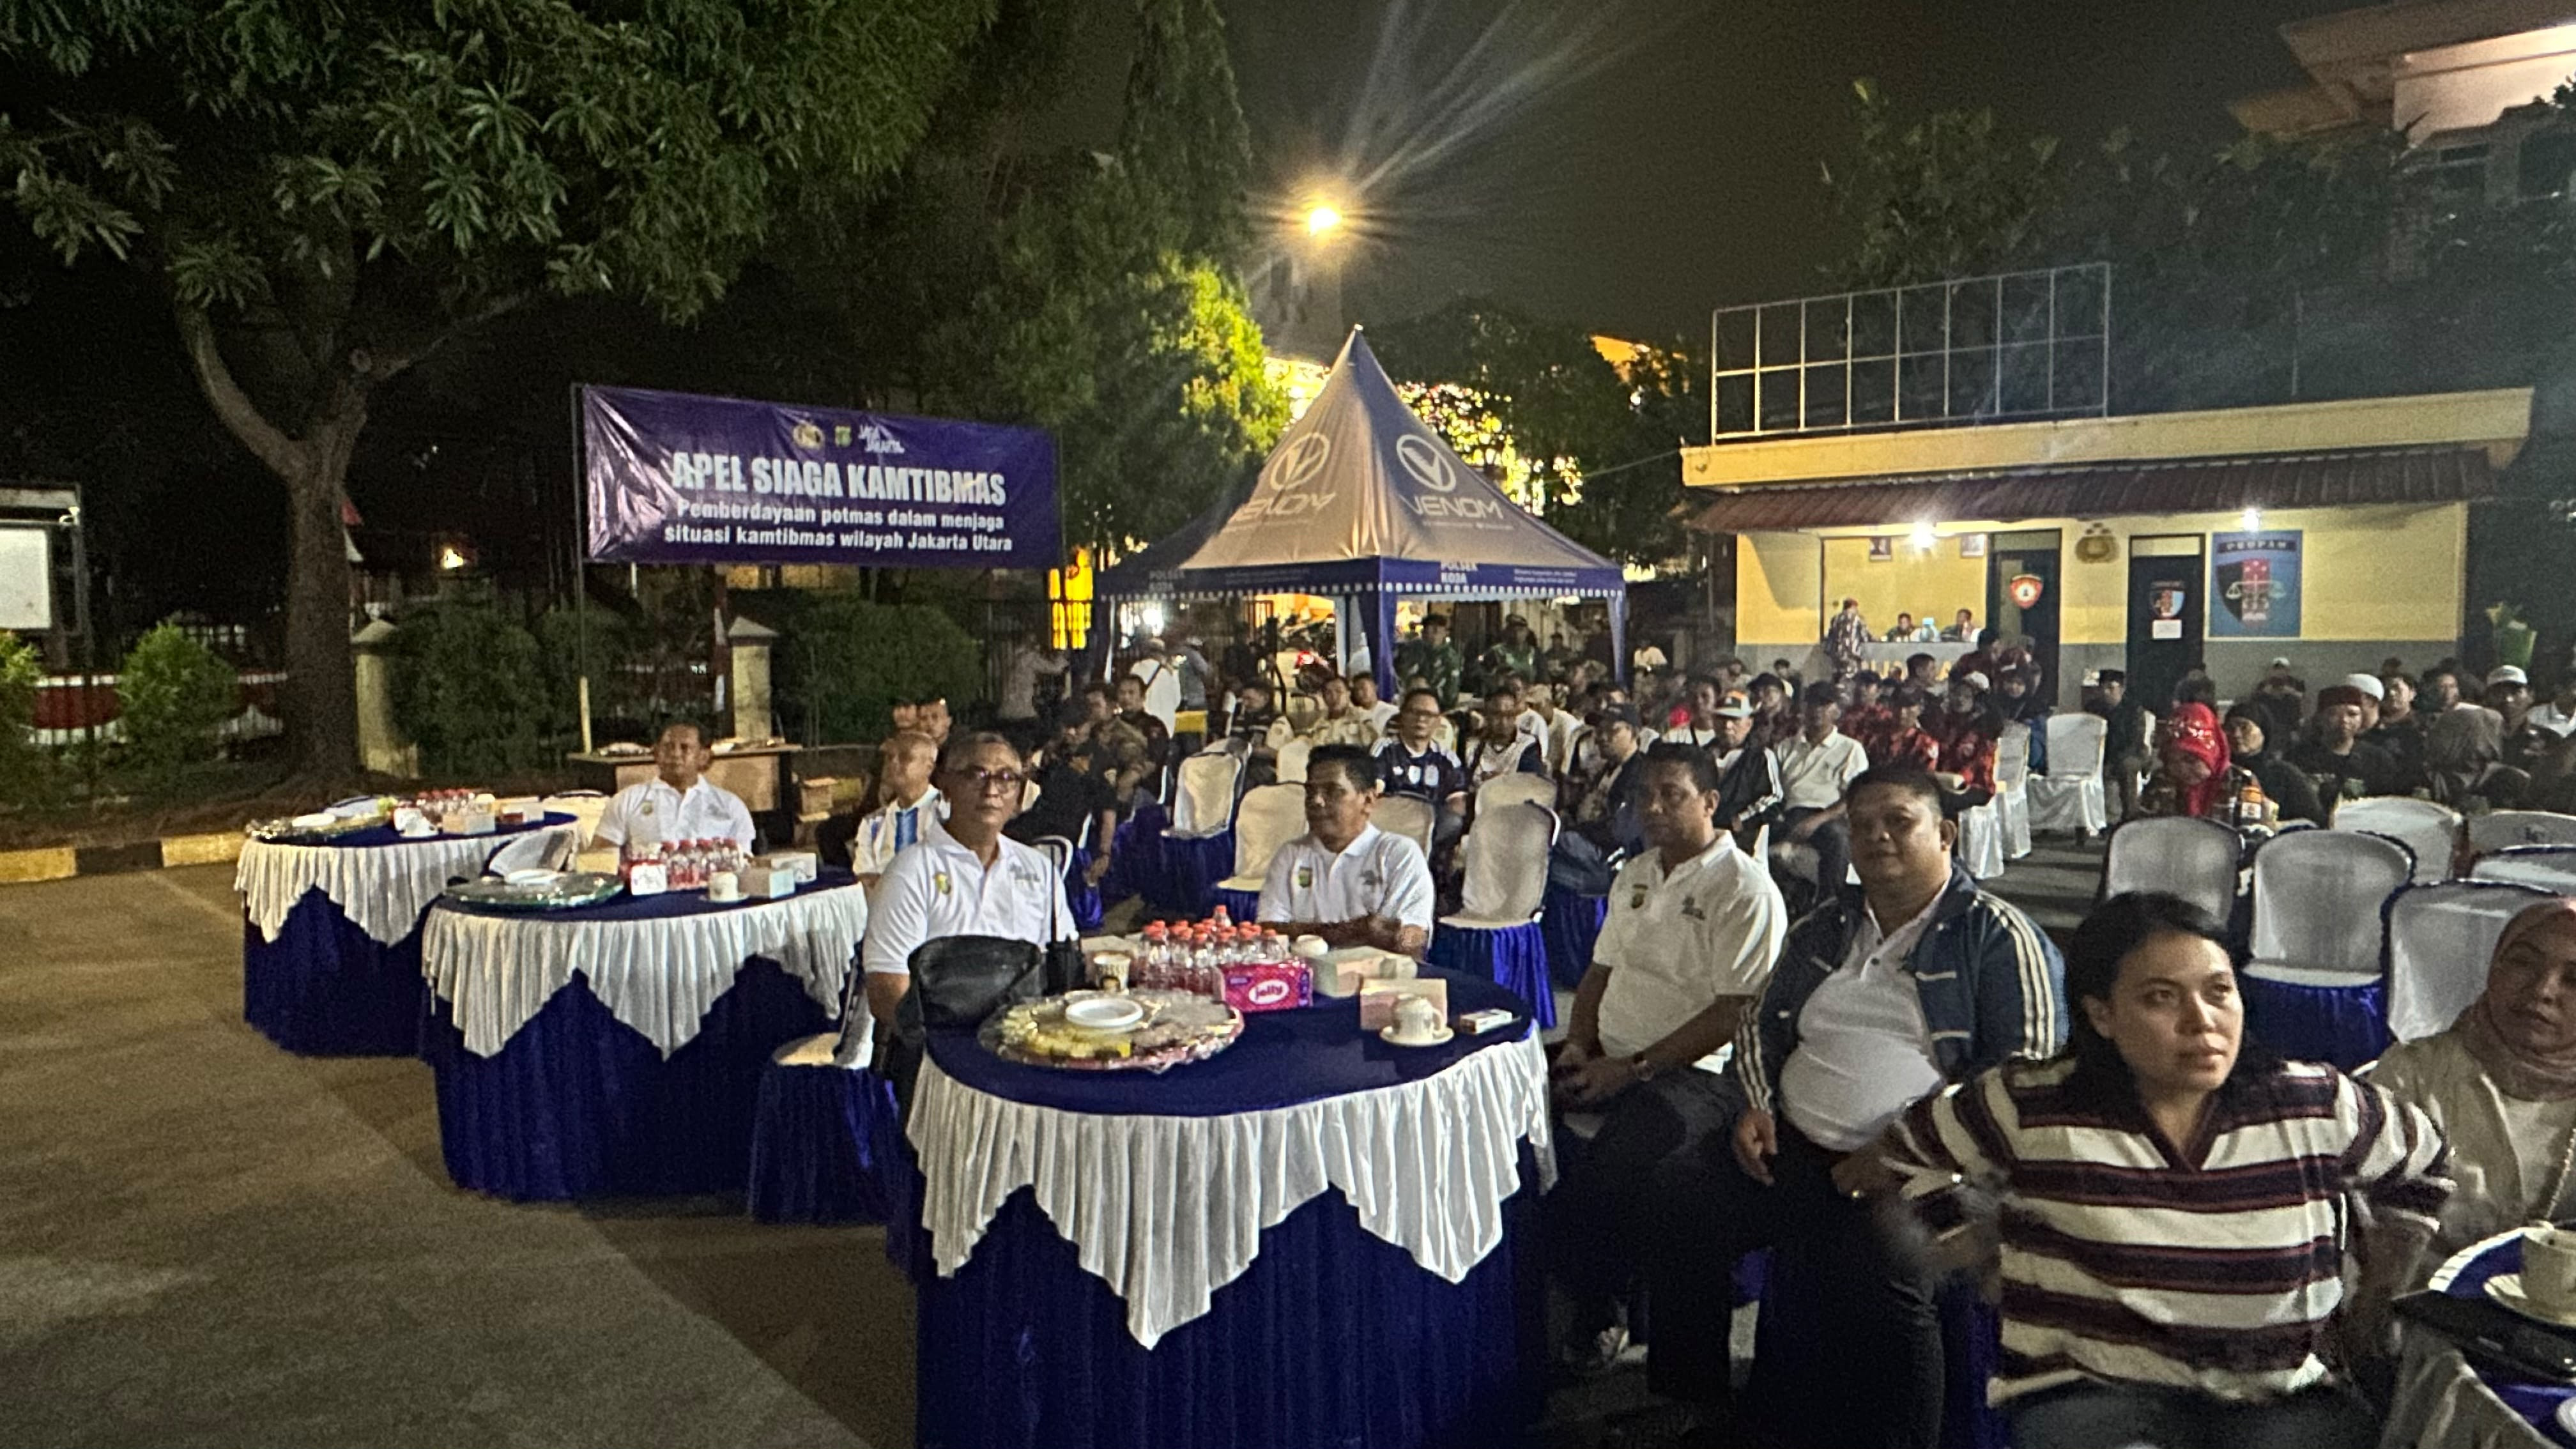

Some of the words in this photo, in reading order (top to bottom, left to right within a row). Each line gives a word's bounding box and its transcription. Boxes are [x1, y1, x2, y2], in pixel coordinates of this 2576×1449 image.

[671, 450, 747, 491] APEL
[751, 456, 843, 497] SIAGA
[847, 463, 1006, 507] KAMTIBMAS
[677, 500, 816, 525] Pemberdayaan
[822, 507, 883, 526] potmas
[888, 509, 937, 527] dalam
[941, 512, 1004, 532] menjaga
[1398, 494, 1504, 519] VENOM
[664, 524, 730, 543] situasi
[737, 526, 836, 546] kamtibmas
[840, 530, 903, 552] wilayah
[907, 532, 968, 550] Jakarta
[973, 533, 1013, 551] Utara
